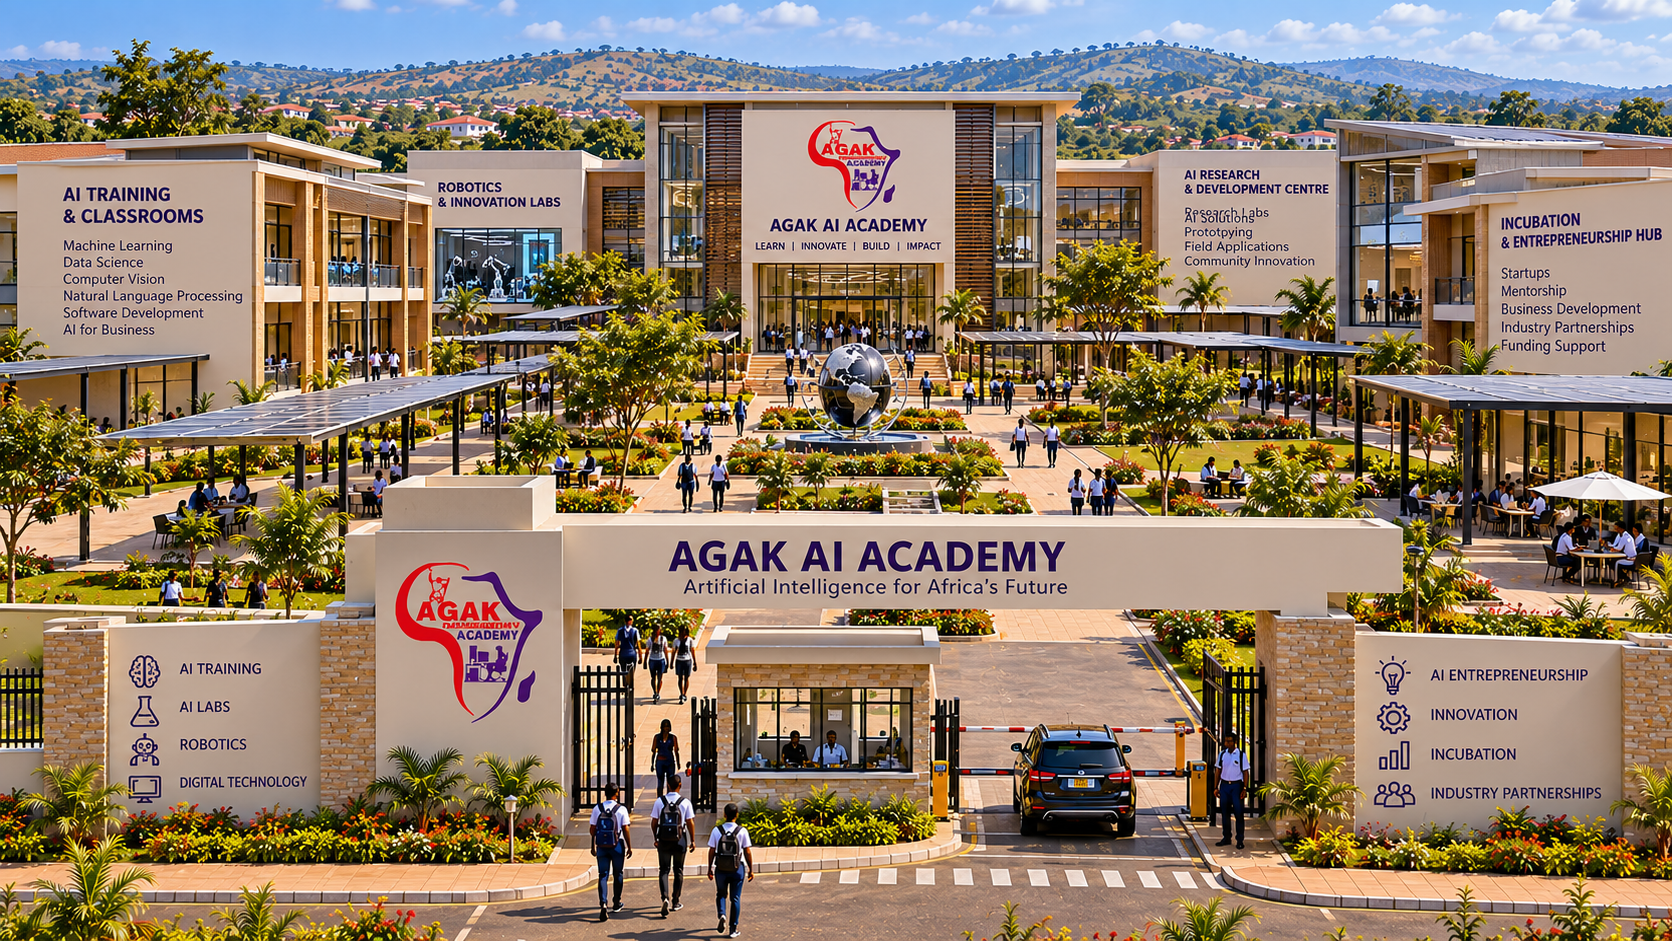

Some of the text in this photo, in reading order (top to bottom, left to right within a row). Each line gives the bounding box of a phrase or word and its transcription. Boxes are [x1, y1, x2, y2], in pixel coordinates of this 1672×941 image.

[821, 143, 875, 155] AGAK
[1184, 170, 1259, 180] AI RESEARCH
[438, 182, 502, 193] ROBOTICS
[1185, 184, 1329, 194] & DEVELOPMENT CENTRE
[63, 187, 170, 201] AI TRAINING
[438, 197, 560, 207] & INNOVATION LABS
[63, 209, 203, 223] & CLASSROOMS
[1502, 213, 1580, 230] INCUBATION
[770, 218, 927, 232] AGAK AI ACADEMY
[1501, 228, 1663, 249] & ENTREPRENEURSHIP HUB
[64, 240, 172, 254] Machine Learning
[756, 242, 785, 250] LEARN
[802, 242, 846, 250] INNOVATE
[863, 242, 890, 250] BUILD
[907, 242, 941, 250] IMPACT
[1185, 241, 1289, 253] Field Applications
[64, 257, 143, 268] Data Science
[1185, 256, 1314, 268] Community Innovation
[63, 274, 164, 287] Computer Vision
[1502, 268, 1550, 281] Startups
[64, 290, 242, 304] Natural Language Processing
[1502, 285, 1566, 298] Mentorship
[64, 307, 203, 321] Software Development
[1502, 302, 1641, 317] Business Development
[63, 324, 154, 335] AI for Business
[1502, 321, 1634, 336] Industry Partnerships
[1502, 339, 1605, 355] Funding Support
[669, 541, 1065, 572] AGAK AI ACADEMY
[684, 578, 1068, 598] Artificial Intelligence for Africa's Future
[416, 601, 501, 621] AGAK
[457, 630, 519, 640] ACADEMY
[180, 663, 261, 674] AI TRAINING
[1431, 669, 1588, 681] AI ENTREPRENEURSHIP
[180, 701, 230, 712] AI LABS
[1432, 709, 1517, 720] INNOVATION
[181, 739, 246, 750] ROBOTICS
[1432, 748, 1516, 760] INCUBATION
[180, 776, 307, 788] DIGITAL TECHNOLOGY
[1432, 787, 1601, 799] INDUSTRY PARTNERSHIPS
